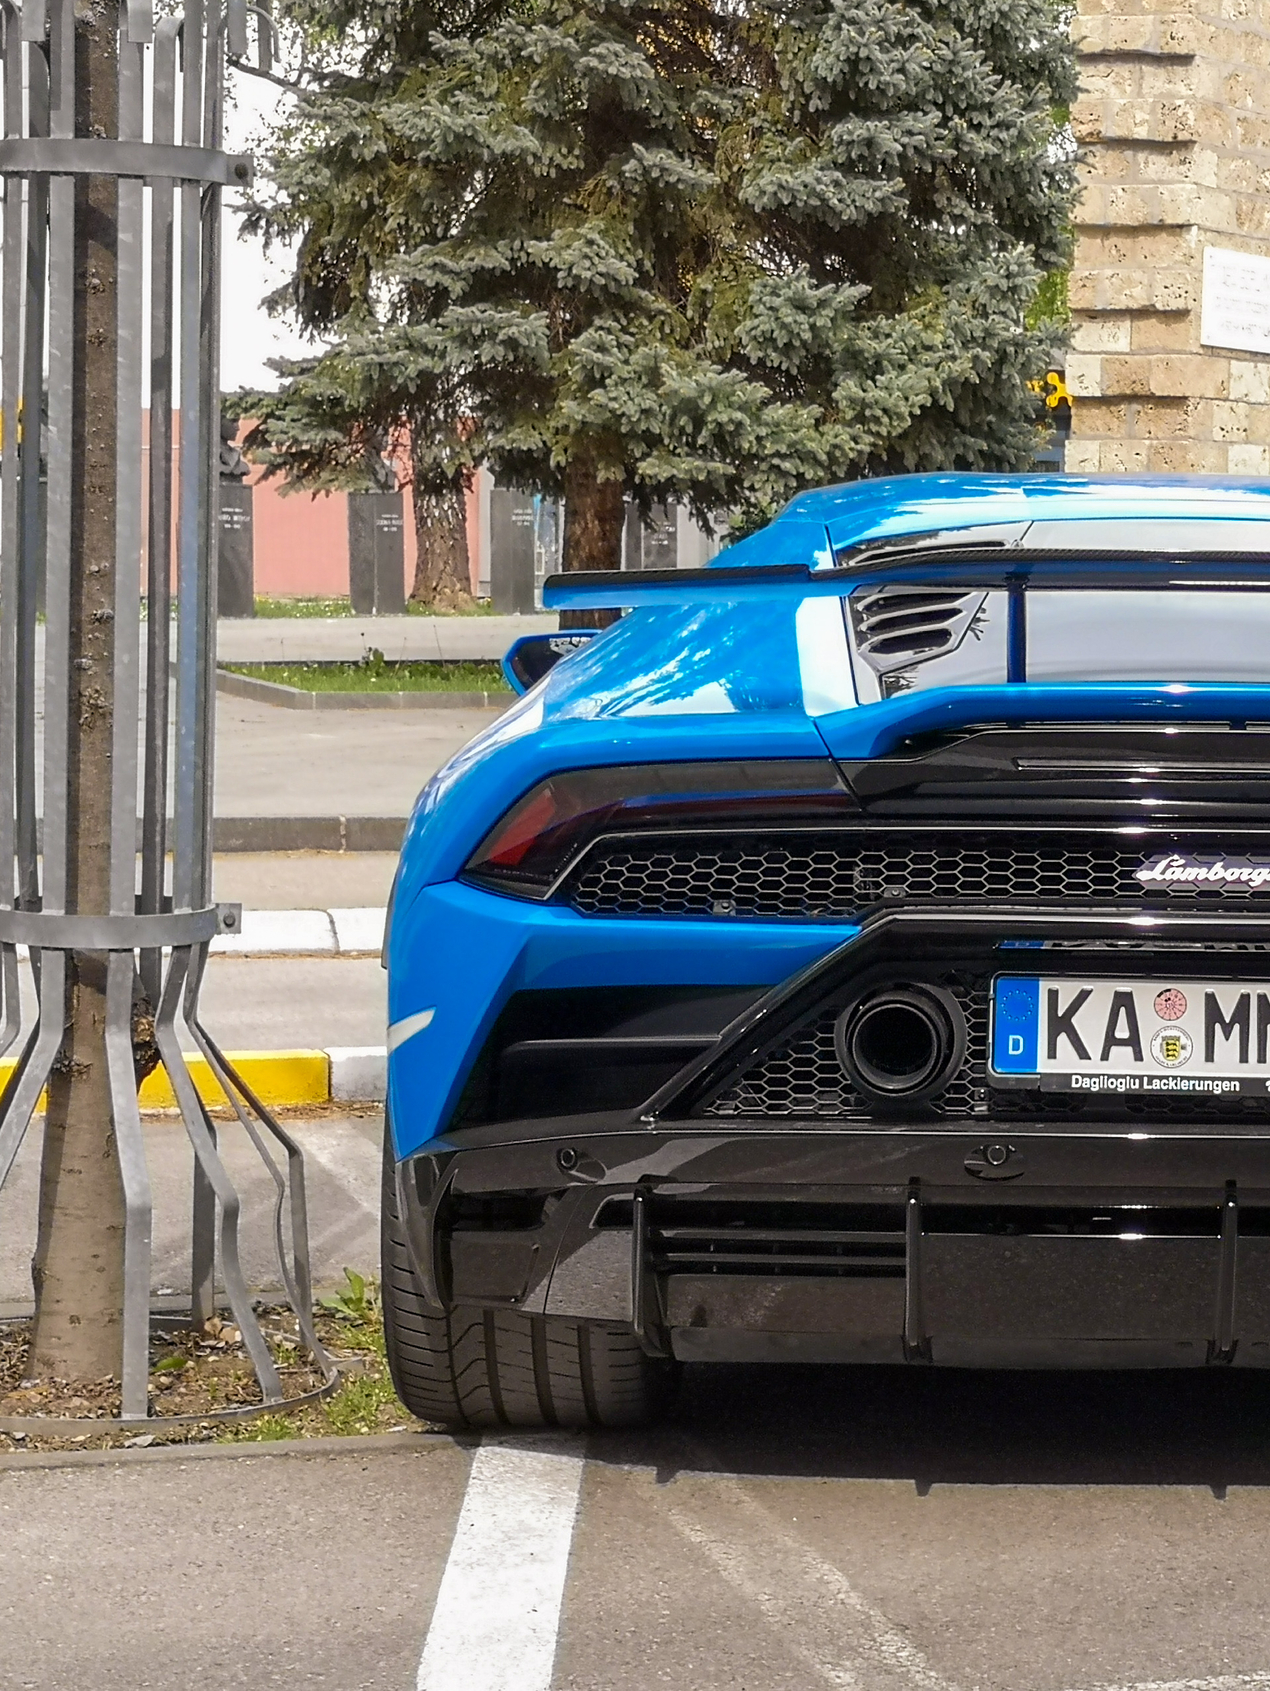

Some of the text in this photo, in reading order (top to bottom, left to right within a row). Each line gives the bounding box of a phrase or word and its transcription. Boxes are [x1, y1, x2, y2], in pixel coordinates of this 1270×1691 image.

[1047, 986, 1144, 1062] KA
[1008, 1035, 1024, 1055] D
[1143, 1076, 1240, 1093] Lackierungen
